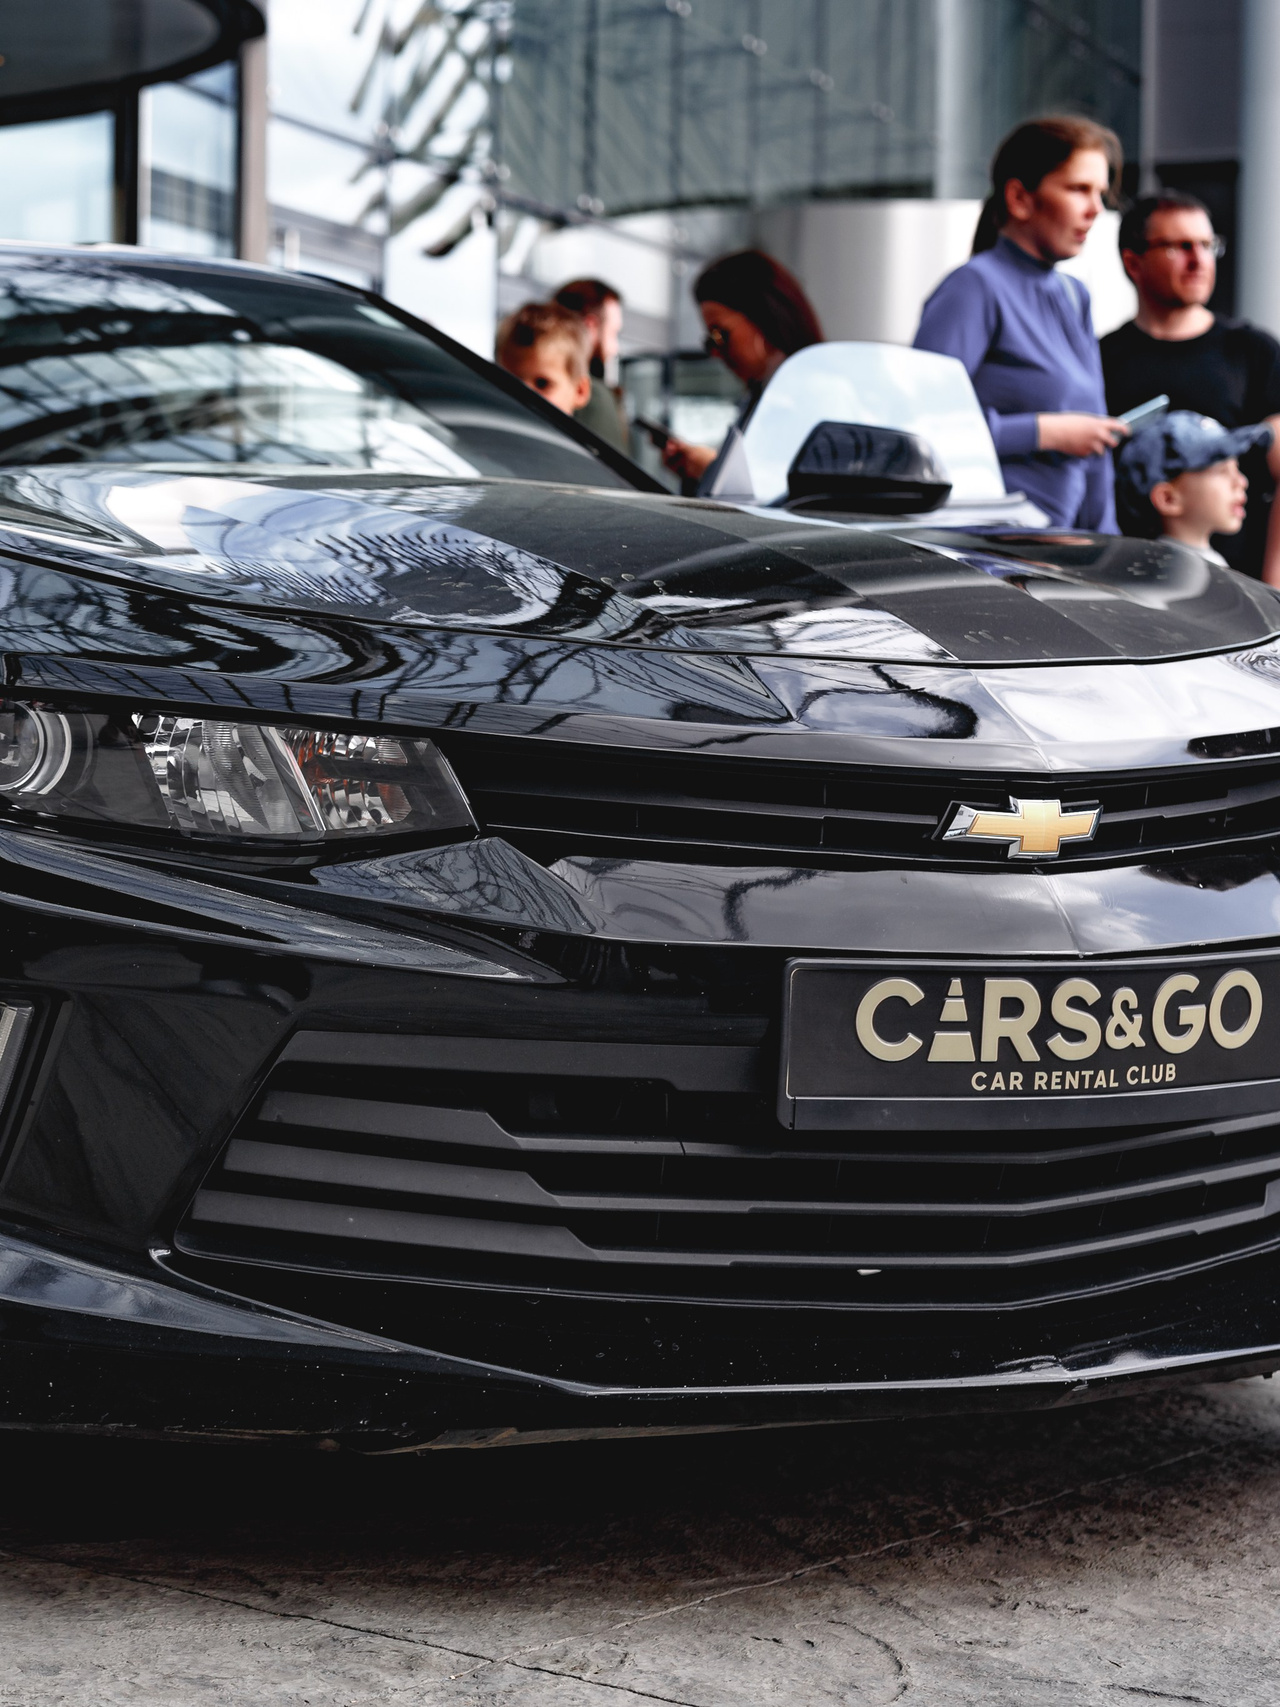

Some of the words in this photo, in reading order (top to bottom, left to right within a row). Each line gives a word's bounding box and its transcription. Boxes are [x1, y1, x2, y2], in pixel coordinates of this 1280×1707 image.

[855, 968, 1263, 1062] CARS&GO
[971, 1071, 1024, 1091] CAR
[1033, 1069, 1120, 1091] RENTAL
[1126, 1063, 1177, 1084] CLUB
